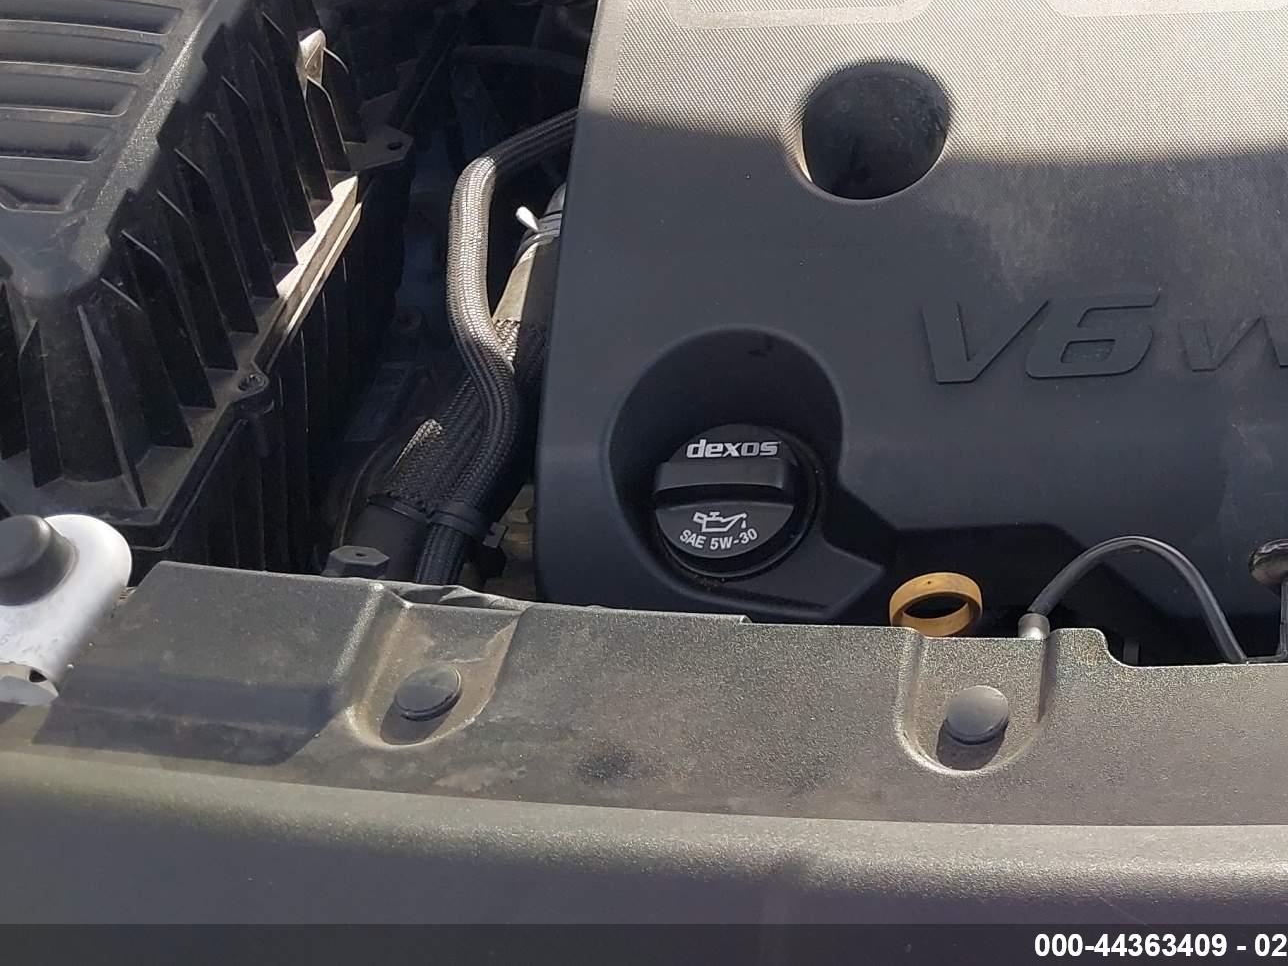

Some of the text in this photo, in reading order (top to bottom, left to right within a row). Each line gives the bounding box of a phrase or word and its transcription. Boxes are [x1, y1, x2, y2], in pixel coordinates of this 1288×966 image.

[921, 287, 1161, 384] V6
[686, 438, 781, 459] dexos
[679, 528, 758, 551] SAE 5W-30
